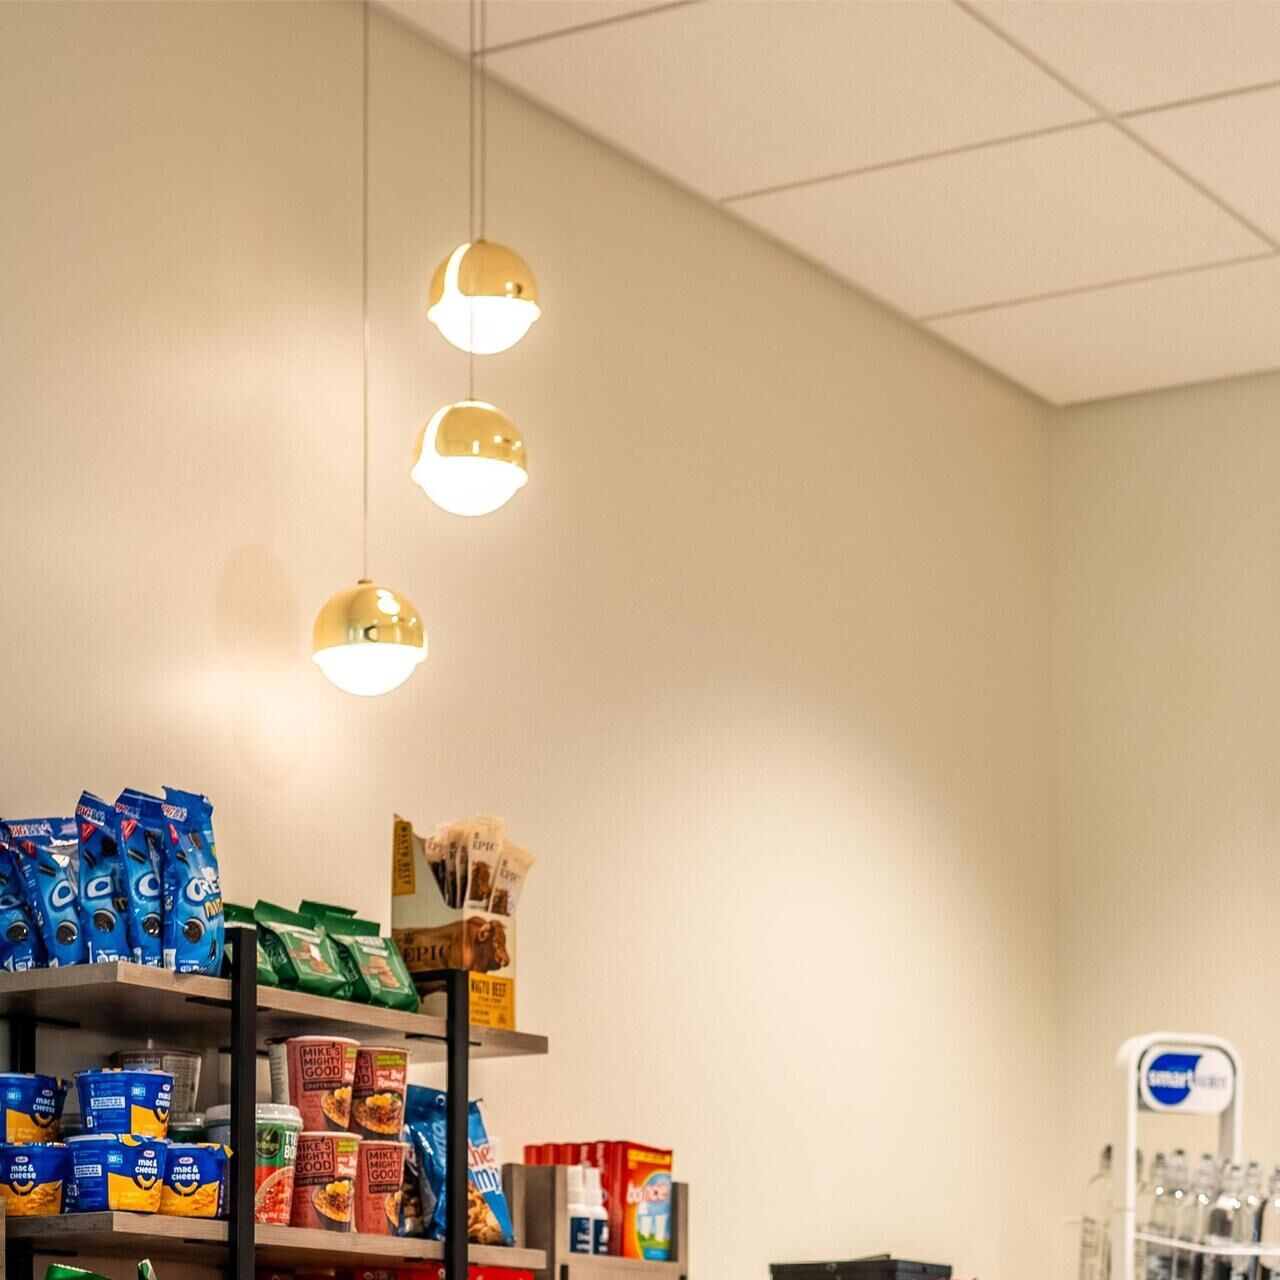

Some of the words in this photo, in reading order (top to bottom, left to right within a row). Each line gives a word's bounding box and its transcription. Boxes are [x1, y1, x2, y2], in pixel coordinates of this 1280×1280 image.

[404, 945, 451, 963] EPIC
[492, 980, 508, 996] BEEF
[303, 1043, 340, 1058] MIKE'S
[304, 1057, 340, 1067] MIGHTY
[305, 1066, 340, 1078] GOOD
[370, 1147, 400, 1161] MIKE'S
[296, 1161, 333, 1174] GOOD
[370, 1160, 400, 1170] MIGHTY
[371, 1170, 400, 1181] GOOD
